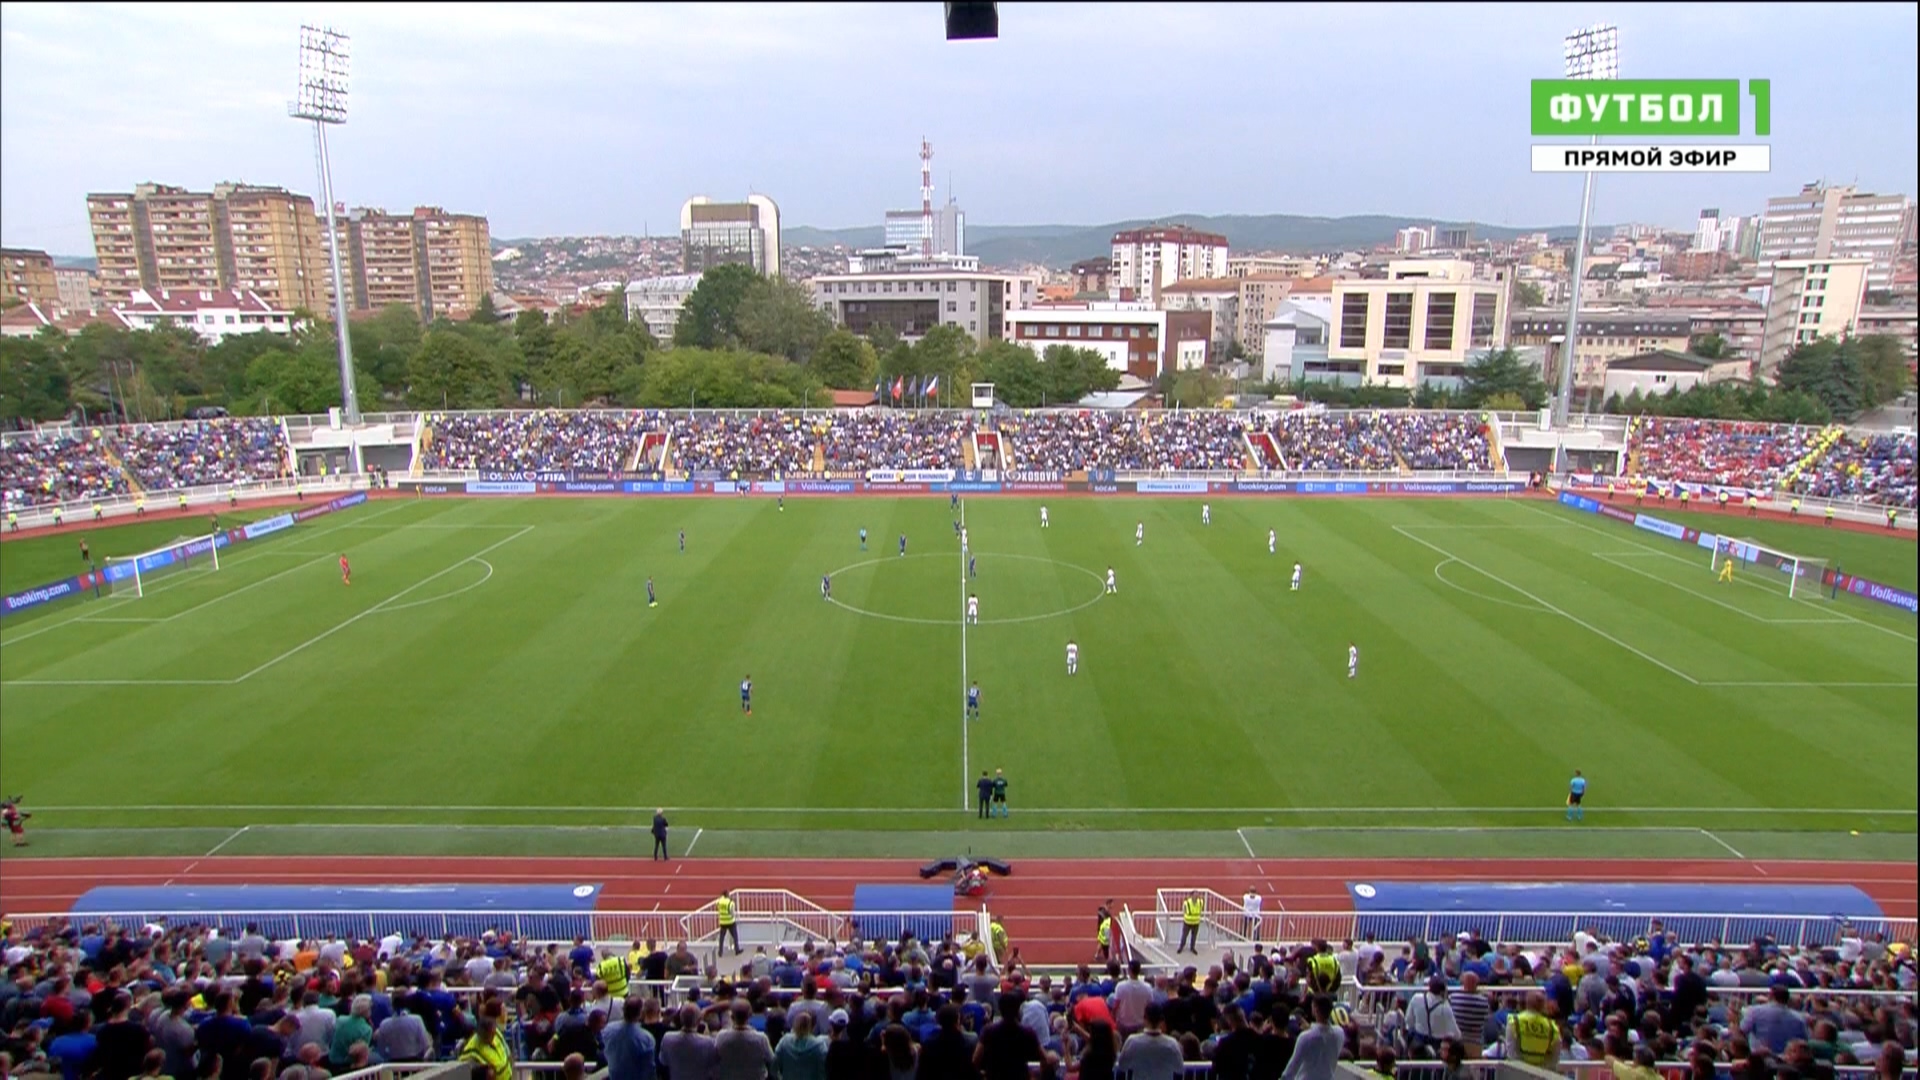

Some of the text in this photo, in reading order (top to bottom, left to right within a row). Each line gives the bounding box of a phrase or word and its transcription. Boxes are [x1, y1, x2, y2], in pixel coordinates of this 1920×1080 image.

[566, 482, 615, 492] Booking.com
[801, 482, 850, 492] Volkswagen
[1238, 482, 1287, 491] Booking.com
[1403, 482, 1451, 492] Volkswagen
[186, 536, 228, 555] Volkswgen
[8, 582, 71, 609] Booking.com
